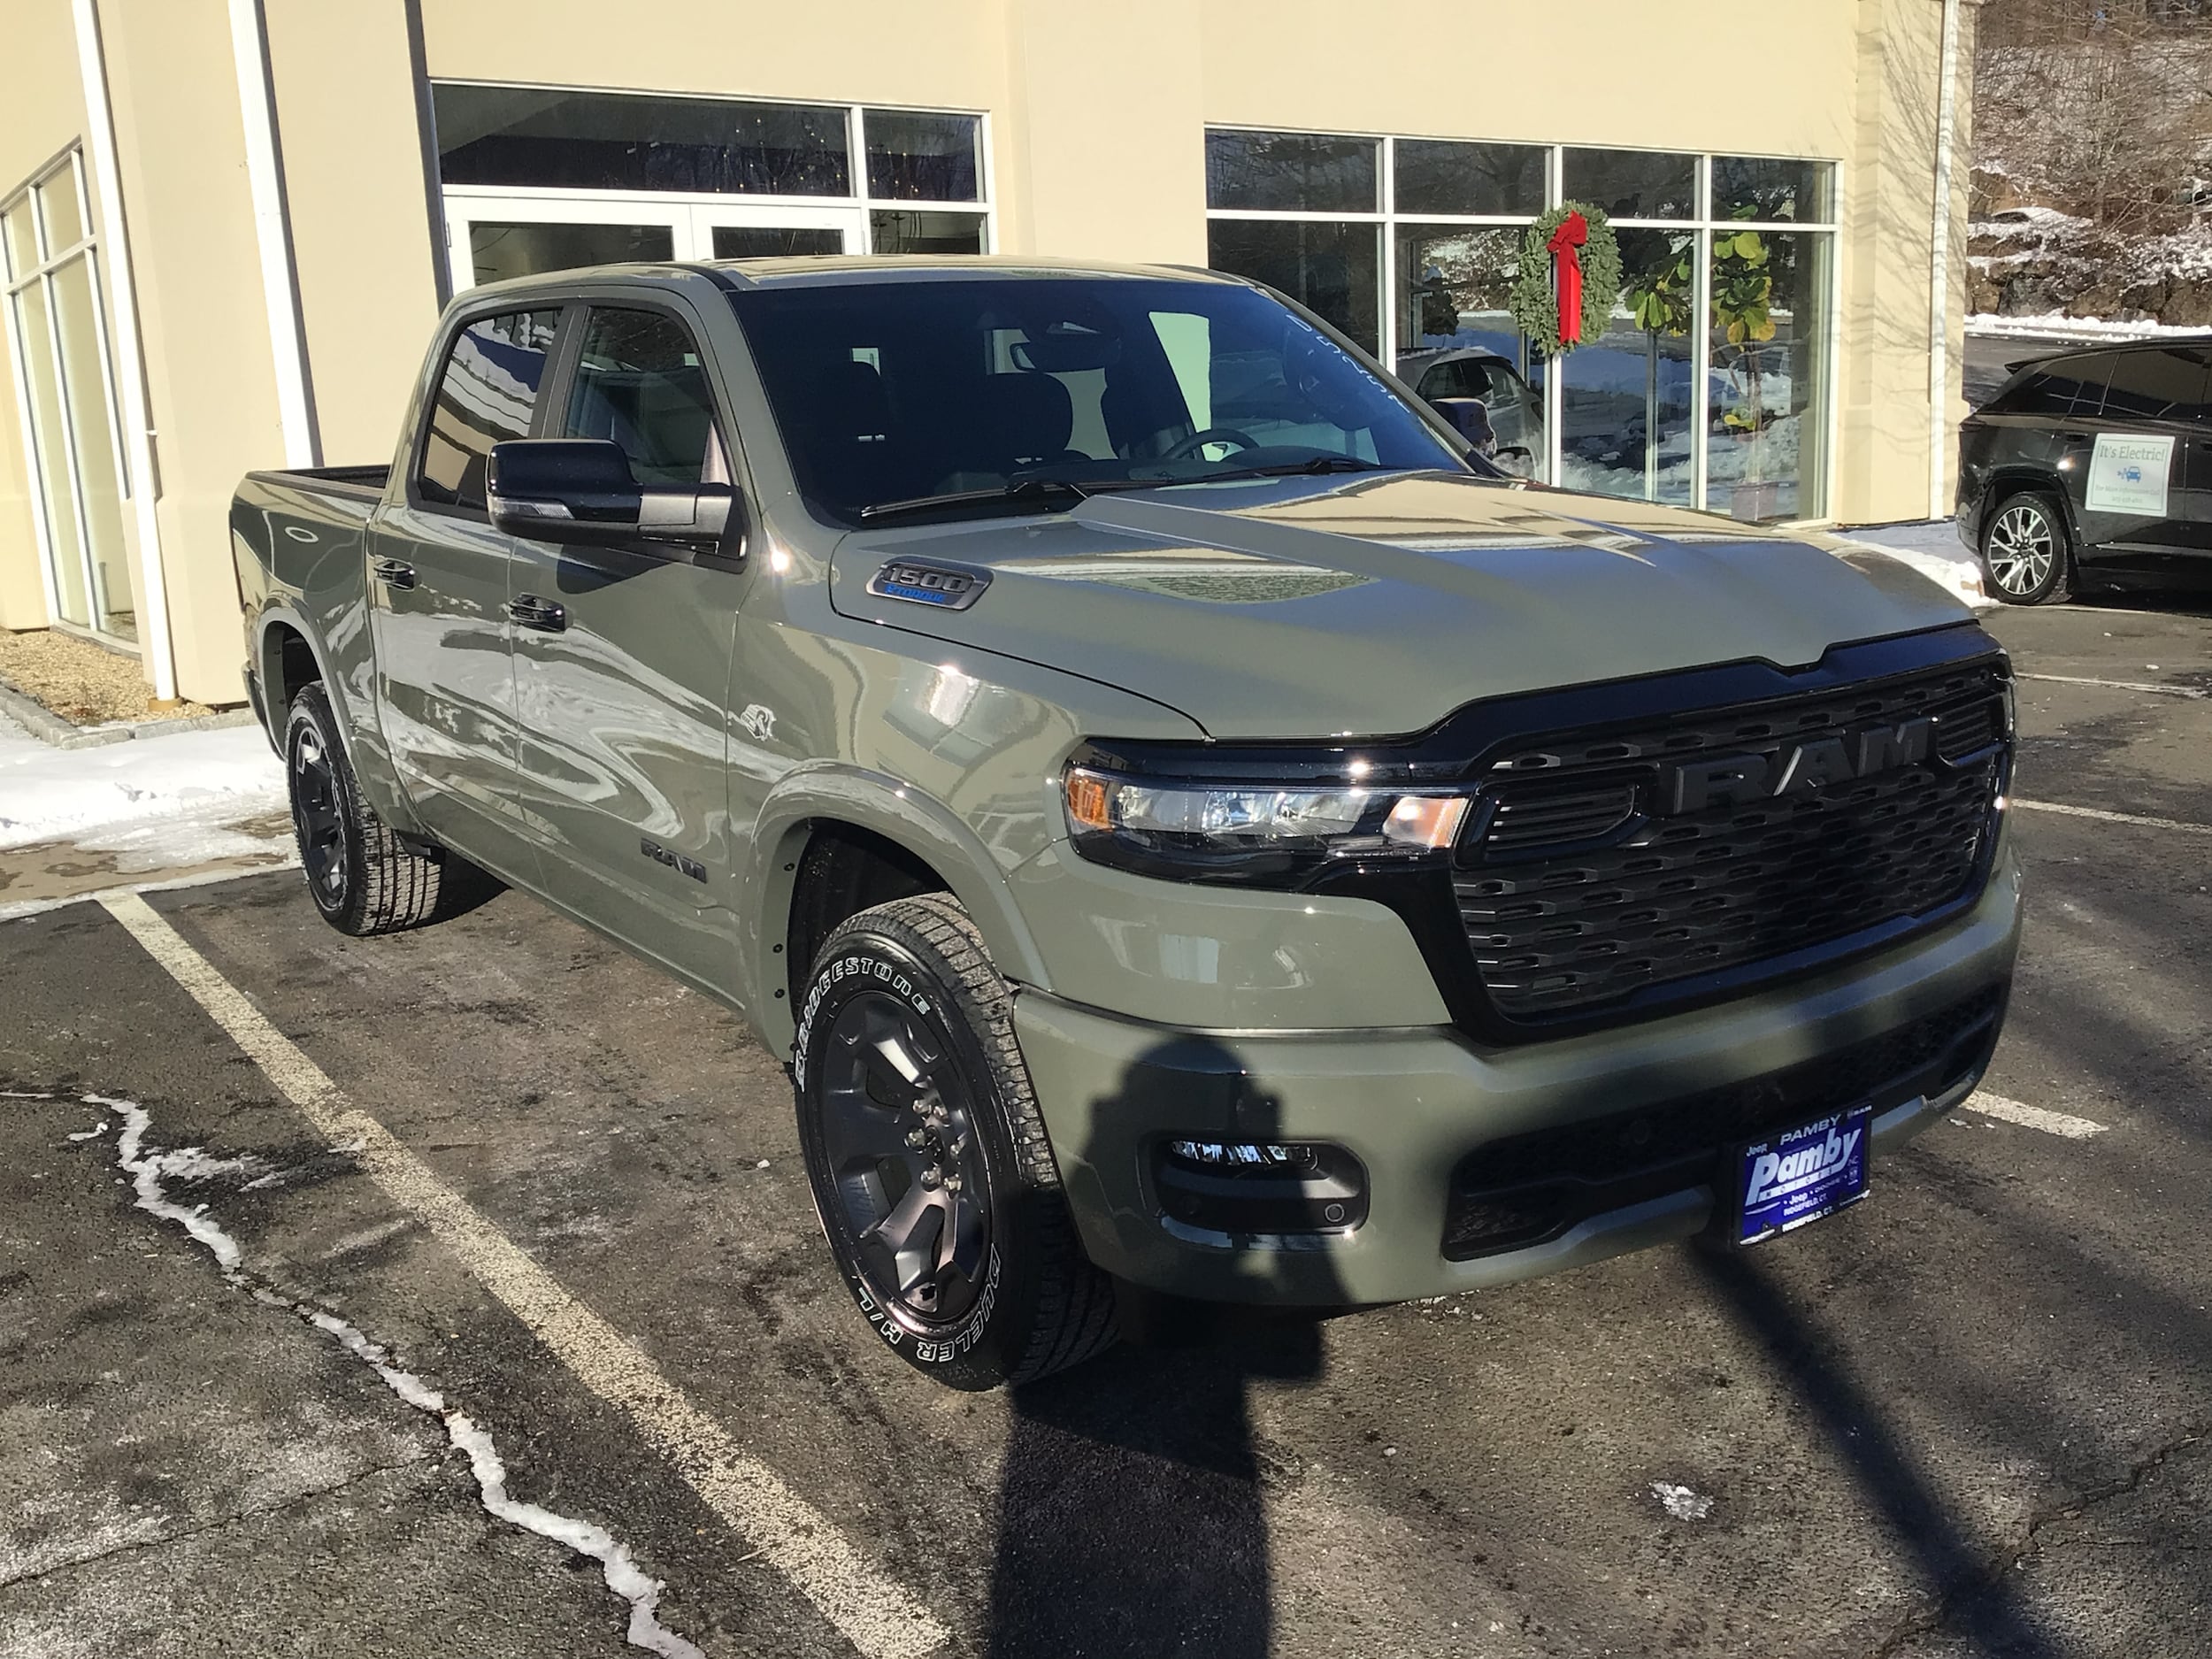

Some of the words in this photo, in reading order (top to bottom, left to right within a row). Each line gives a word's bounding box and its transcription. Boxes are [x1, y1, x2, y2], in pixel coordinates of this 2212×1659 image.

[2099, 445, 2117, 458] It's
[2118, 445, 2165, 462] Electric!
[889, 567, 972, 593] 1500
[1671, 717, 1931, 814] RAM
[640, 837, 708, 885] RAM
[795, 956, 931, 1093] BRIDGESTONE
[1780, 1114, 1841, 1146] PAMBY
[1745, 1127, 1862, 1207] Pamby
[1789, 1192, 1809, 1205] Jeep
[915, 1242, 1002, 1363] DUELER
